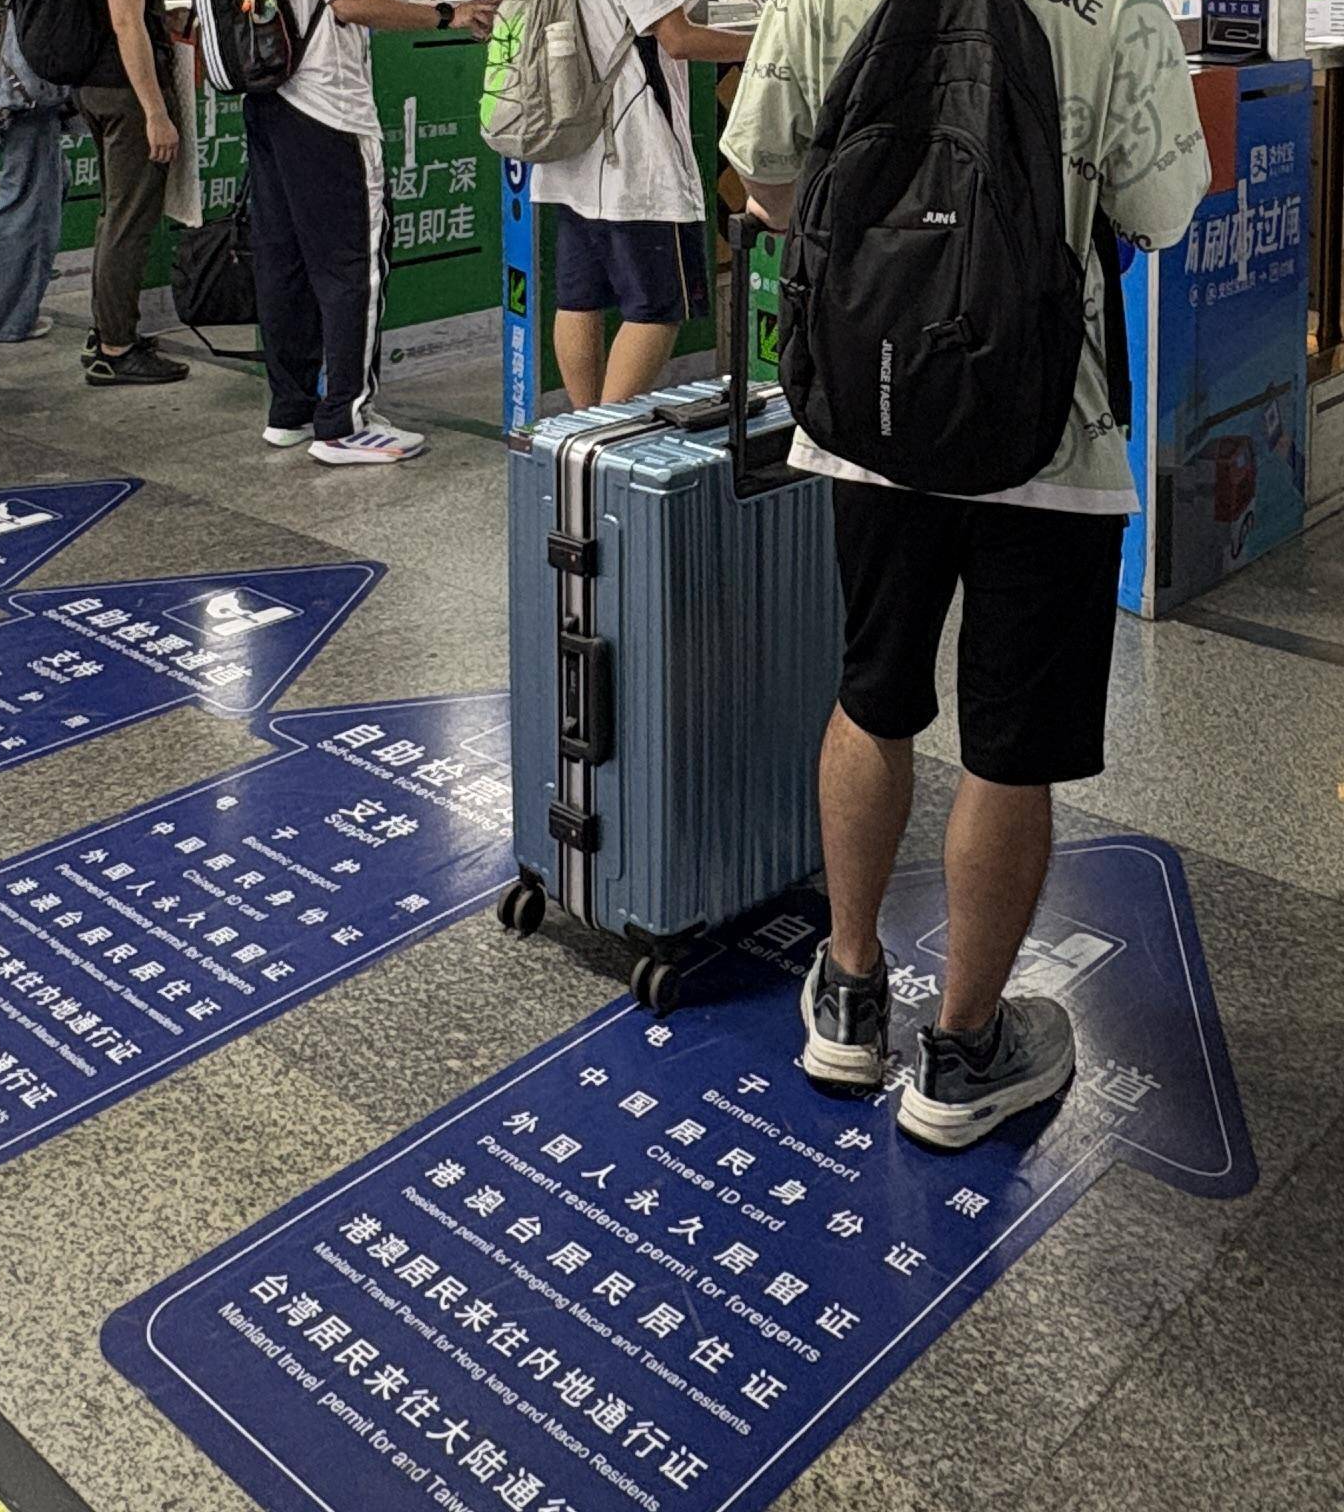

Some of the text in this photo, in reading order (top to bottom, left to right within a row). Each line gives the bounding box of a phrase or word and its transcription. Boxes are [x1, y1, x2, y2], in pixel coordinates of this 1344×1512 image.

[77, 847, 298, 982] 外国人永久居留证
[317, 812, 387, 849] Support
[334, 796, 427, 841] 支持
[2, 876, 225, 1021] 港澳台居民居住证
[499, 1108, 864, 1341] 外国人永久居留证
[570, 1064, 930, 1277] 中国居民身份证
[637, 1022, 993, 1220] 电子护照
[642, 1143, 787, 1233] Chinese ID card
[699, 1088, 863, 1184] Biometric passport
[334, 1211, 713, 1491] 港澳居民来往内地通行证
[396, 1186, 757, 1437] Residence permit for Hongkong Macao and Taiwan residents
[420, 1157, 792, 1411] 港澳台居民居住证
[472, 1134, 826, 1365] Permanent residence permit for foreigenrs
[212, 1300, 478, 1512] Mainland travel permit for and Taiw
[308, 1241, 665, 1512] Mainland Travel Permit for Hong kang and Macao Residents
